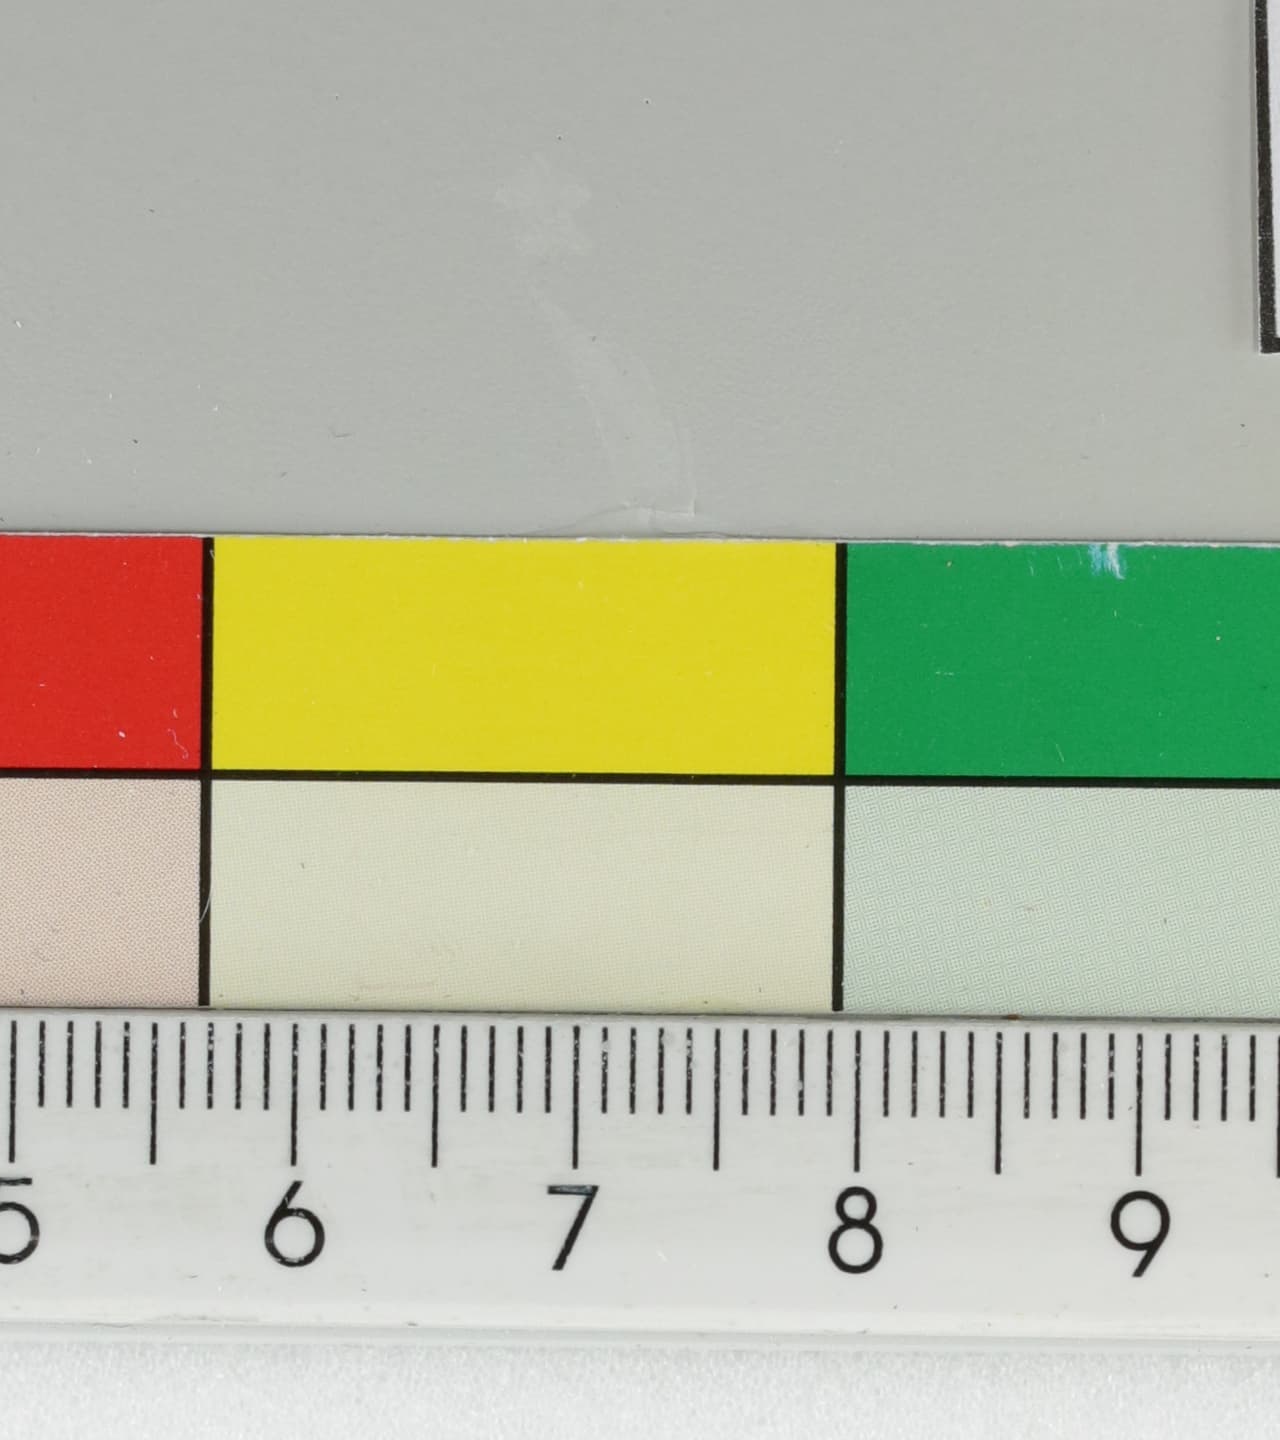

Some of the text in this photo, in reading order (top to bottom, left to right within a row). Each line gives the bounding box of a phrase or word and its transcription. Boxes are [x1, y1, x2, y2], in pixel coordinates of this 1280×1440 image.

[263, 1179, 326, 1269] 6
[546, 1183, 601, 1272] 7
[826, 1185, 885, 1275] 8
[1109, 1189, 1172, 1279] 9
